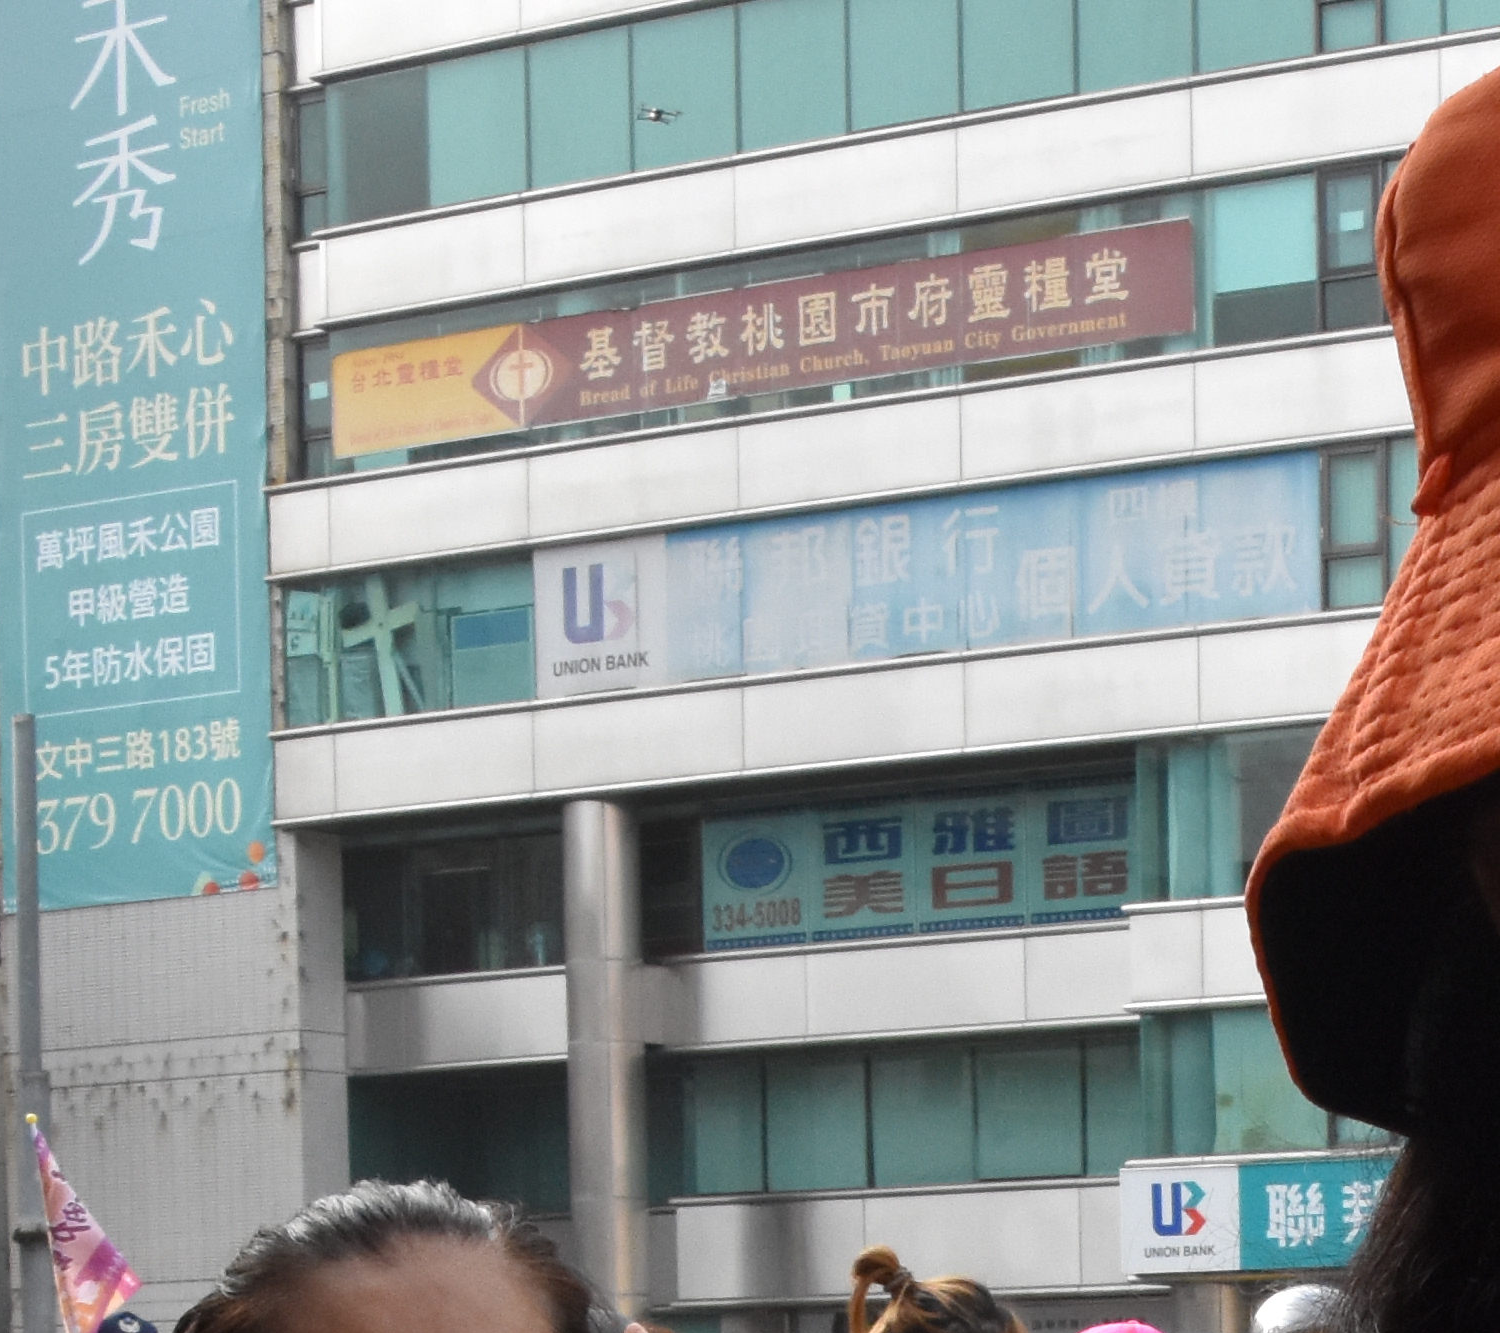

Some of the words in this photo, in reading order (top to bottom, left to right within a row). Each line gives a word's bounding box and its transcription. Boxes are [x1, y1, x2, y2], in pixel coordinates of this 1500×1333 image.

[179, 88, 231, 117] Fresh
[180, 122, 225, 149] Start
[580, 248, 1130, 381] 基督教桃園市府靈糧堂
[21, 298, 235, 396] 中路禾心
[580, 384, 631, 407] Bread
[639, 378, 657, 398] of
[665, 374, 699, 393] Life
[879, 335, 954, 363] Taoyuan
[964, 329, 1002, 351] City
[1011, 312, 1128, 343] Government
[22, 383, 235, 479] 三房雙併
[35, 506, 220, 572] 萬坪風禾公園
[68, 574, 191, 627] 甲級營造
[45, 632, 215, 689] 5年防水保固
[553, 656, 600, 678] UNION
[606, 651, 650, 672] BANK
[36, 718, 241, 781] 文中三路183號
[36, 792, 116, 855] 379
[130, 778, 242, 843] 7000
[823, 850, 1129, 920] 美日語
[1144, 1247, 1177, 1258] UNION
[1183, 1246, 1215, 1257] BANK
